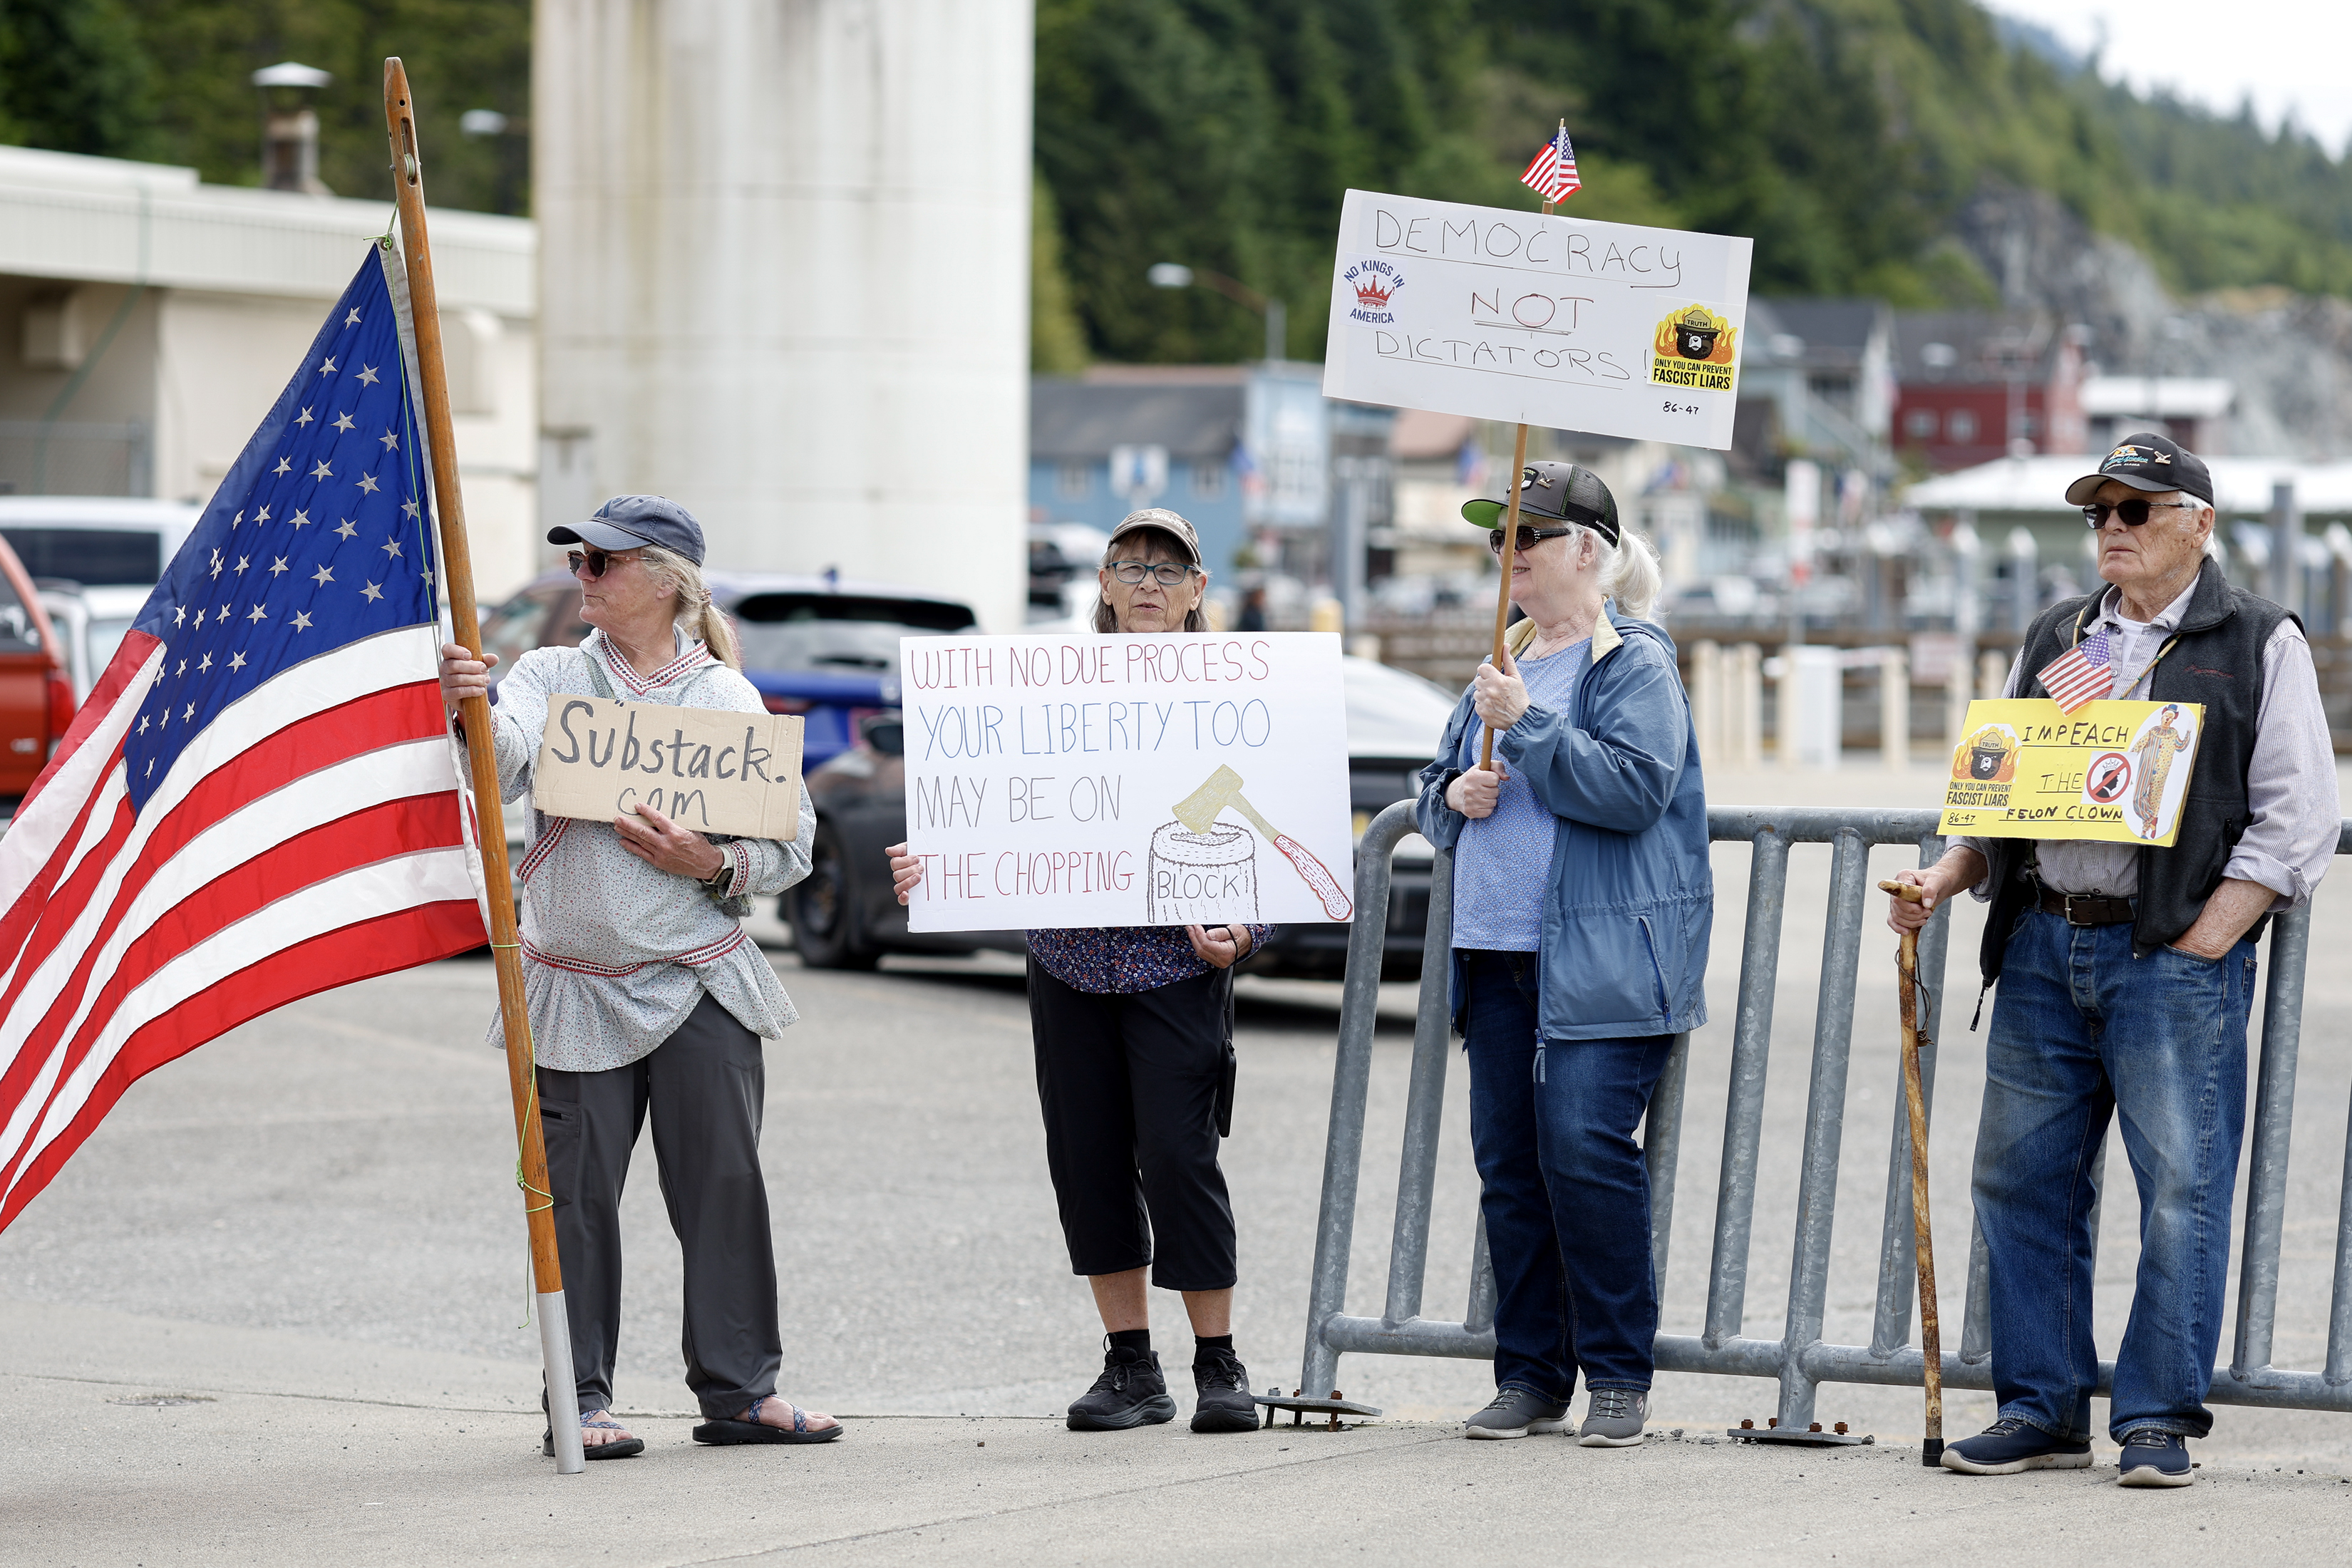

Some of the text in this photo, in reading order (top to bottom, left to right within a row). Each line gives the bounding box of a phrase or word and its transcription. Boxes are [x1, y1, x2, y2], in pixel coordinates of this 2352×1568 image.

[1376, 210, 1681, 287] DEMOCRACY
[1343, 260, 1405, 288] NO KINGS IN
[1349, 308, 1395, 324] AMERICA
[1472, 288, 1594, 329] NOT
[1686, 319, 1708, 328] TRUTH
[1654, 368, 1731, 390] FASCIST LIARS
[1655, 358, 1732, 376] ONLY YOU CAN PREVENT
[1662, 401, 1699, 415] 86-47
[912, 640, 1270, 690] WITH NO DUE PROCESS
[551, 699, 787, 783] Substack.
[918, 698, 1271, 761] YOUR LIBERTY TOO
[2021, 722, 2129, 746] IMPEACH
[1949, 781, 2012, 793] ONLY YOU CAN PREVENT
[2040, 772, 2083, 792] THE
[617, 787, 710, 827] com
[917, 775, 1121, 830] MAY BE ON
[1946, 791, 2008, 806] FASCIST LIARS
[1947, 812, 1976, 823] 86-47
[2006, 805, 2123, 820] FELON CLOWN
[918, 850, 1135, 902] THE CHOPPING
[1157, 870, 1240, 899] BLOCK
